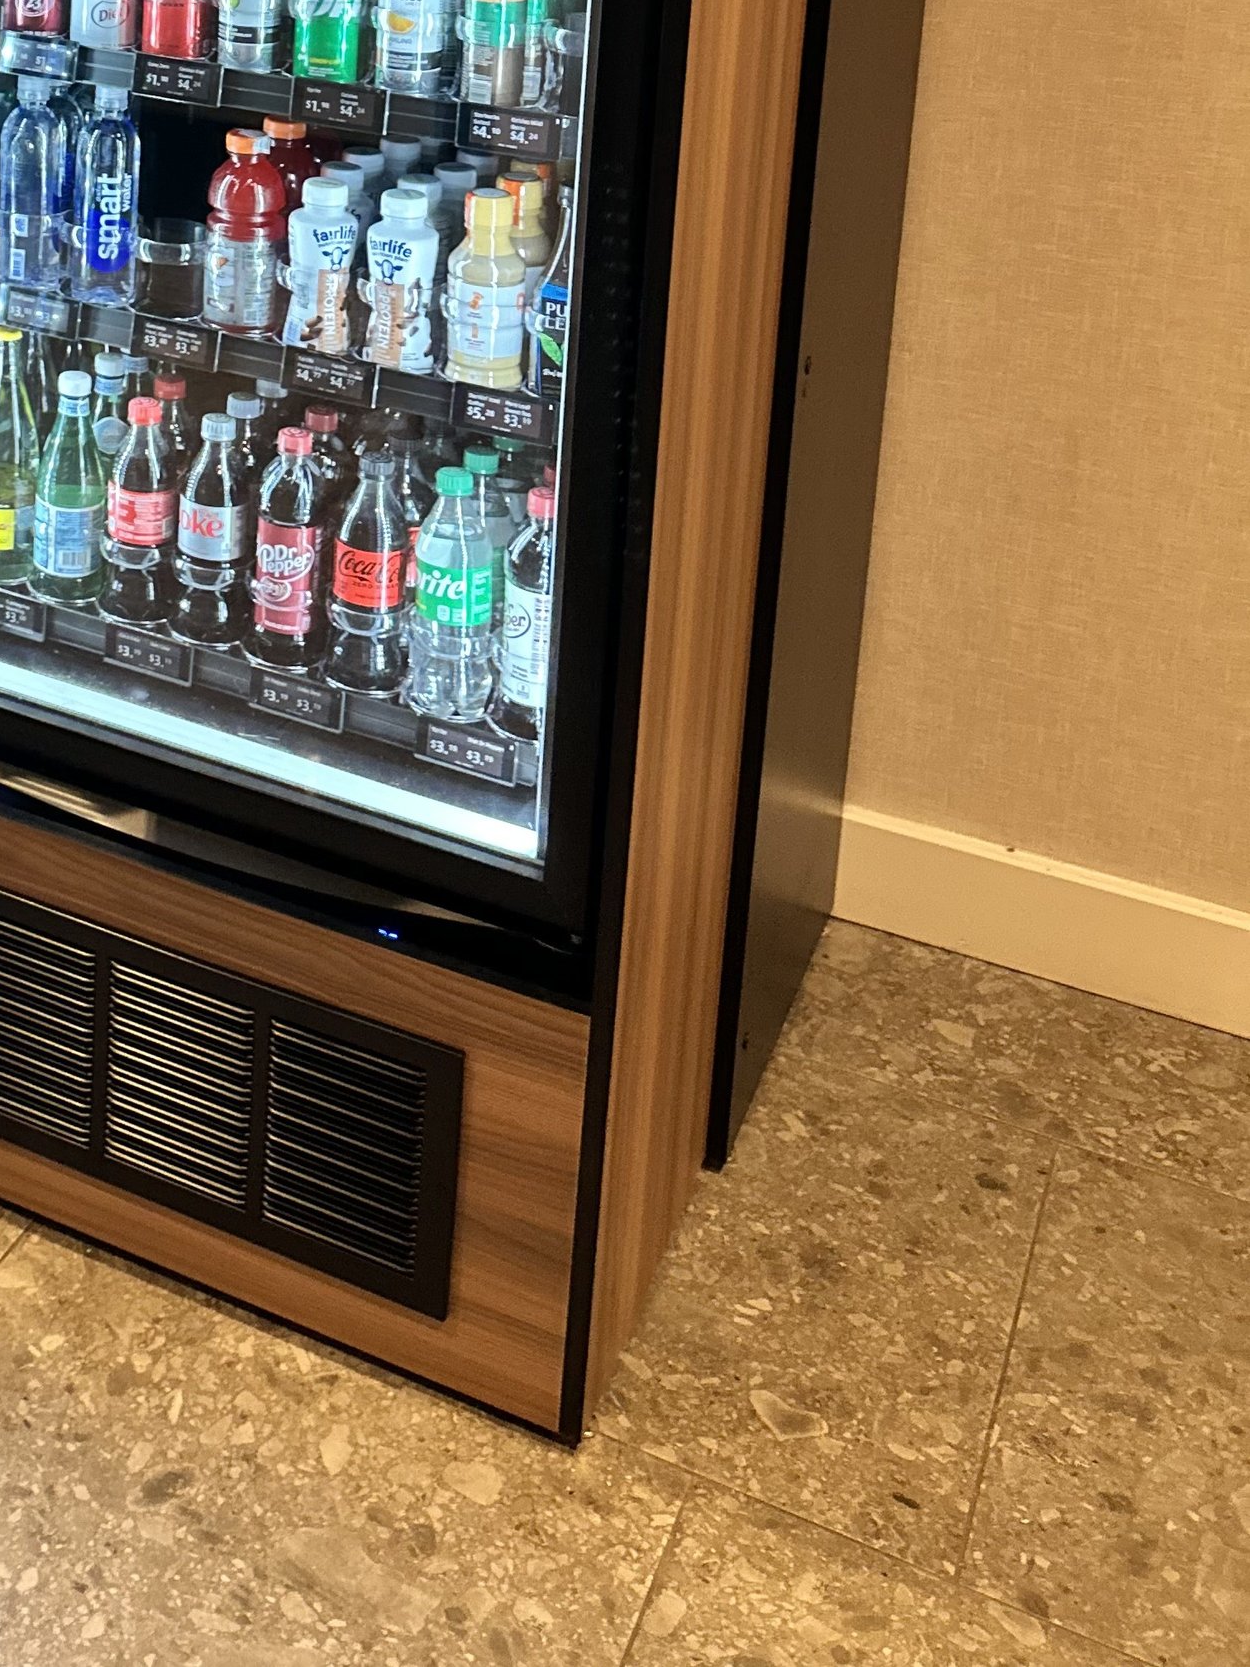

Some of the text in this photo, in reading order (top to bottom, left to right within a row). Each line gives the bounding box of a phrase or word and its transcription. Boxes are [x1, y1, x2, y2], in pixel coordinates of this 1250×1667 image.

[121, 172, 133, 213] water
[96, 173, 123, 261] smart
[313, 225, 356, 243] fairlife
[370, 236, 412, 258] fairlife
[376, 293, 391, 348] PROTEIN
[545, 302, 567, 317] PU
[254, 544, 312, 577] Pepper
[278, 544, 297, 558] Dr
[352, 581, 373, 589] ZERO
[417, 569, 465, 600] rite
